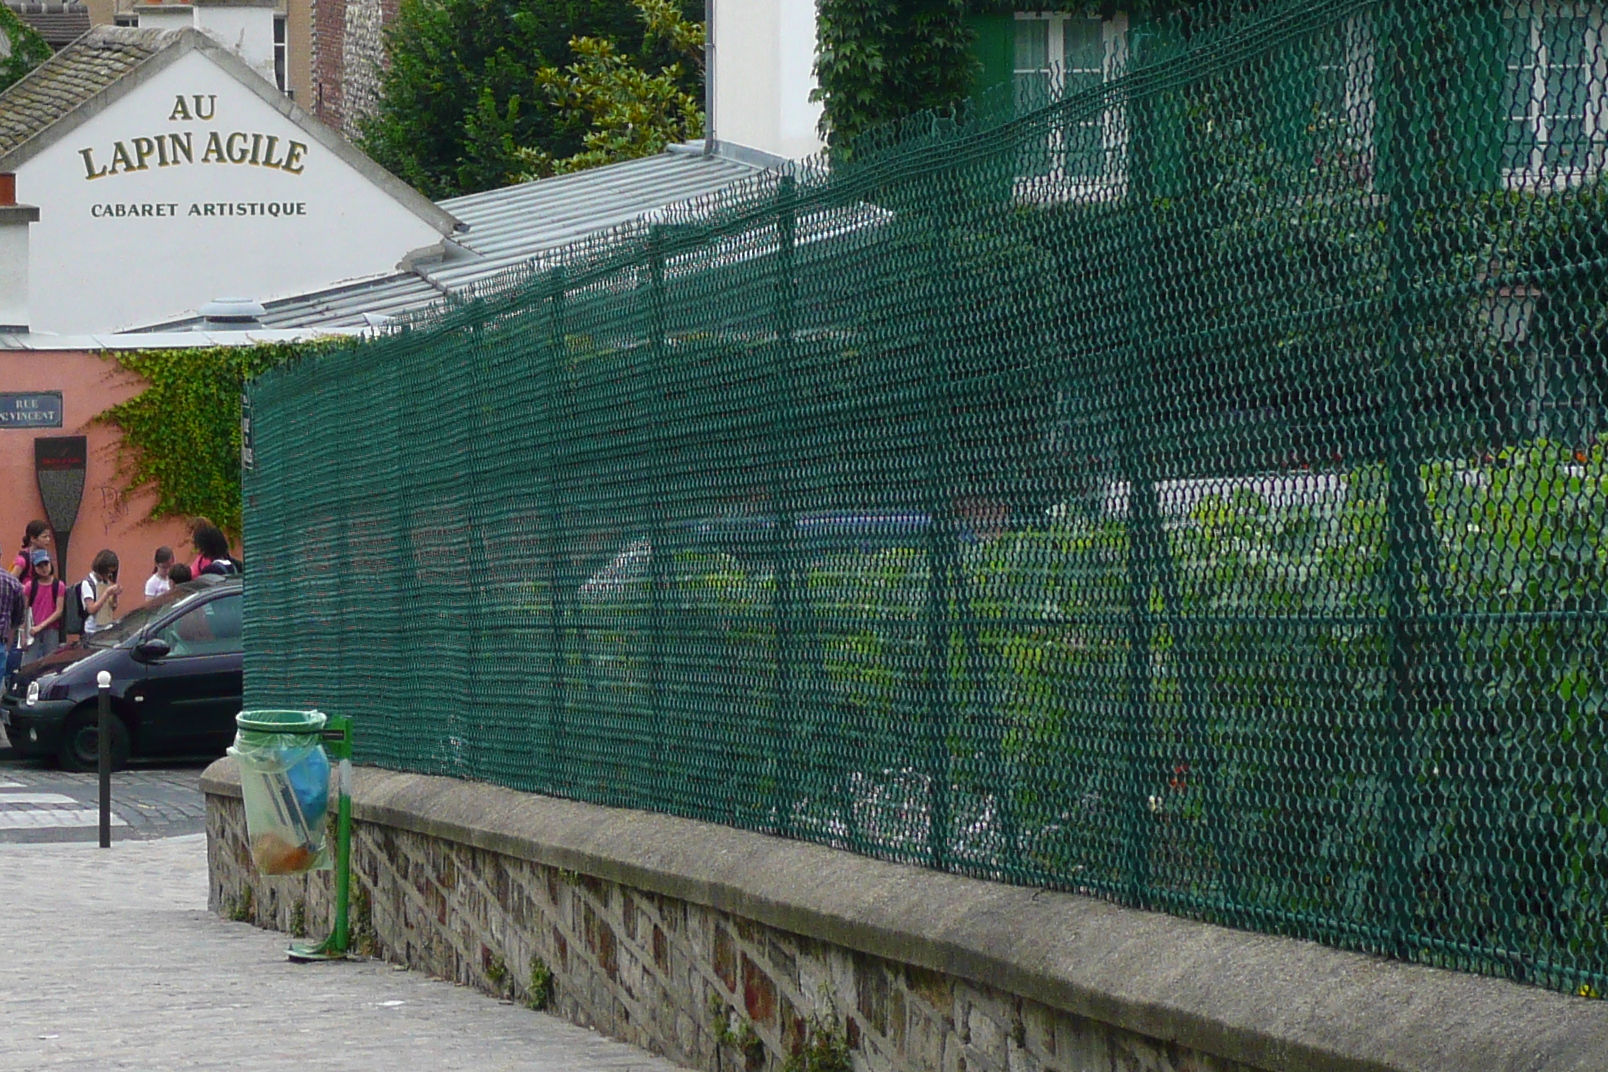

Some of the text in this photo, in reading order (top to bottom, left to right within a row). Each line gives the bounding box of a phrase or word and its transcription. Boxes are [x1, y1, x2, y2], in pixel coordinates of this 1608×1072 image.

[169, 95, 217, 120] AU
[78, 131, 308, 180] LAPIN AGILE
[91, 202, 307, 217] CABARET ARTISTIQUE
[15, 399, 39, 409] RUE
[10, 411, 55, 421] VINCENT
